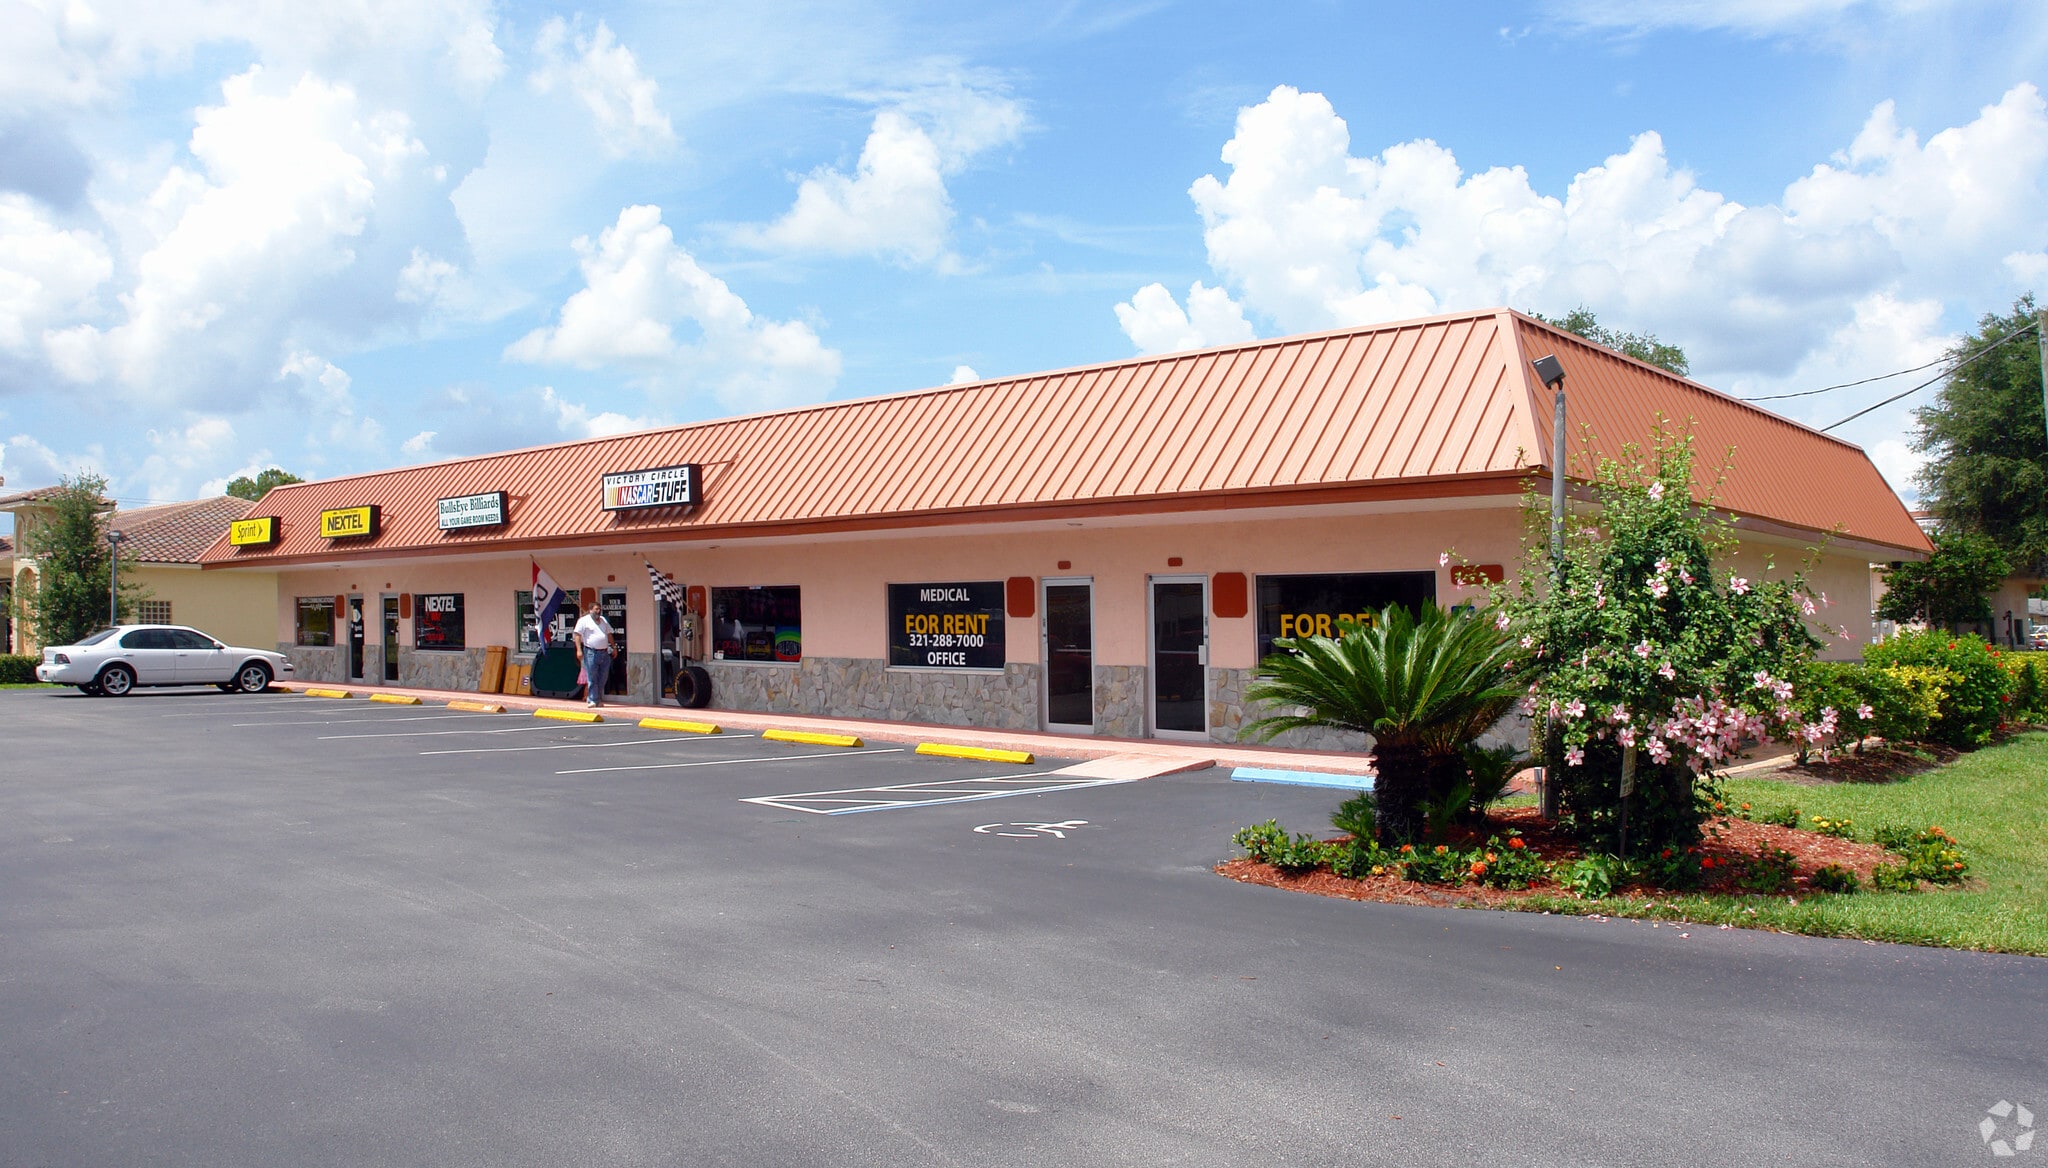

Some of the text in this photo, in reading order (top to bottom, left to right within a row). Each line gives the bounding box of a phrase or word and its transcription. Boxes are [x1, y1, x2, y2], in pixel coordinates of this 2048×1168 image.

[607, 469, 685, 485] VICTORY CIRCLE
[620, 480, 687, 505] NASCAR STUFF
[440, 496, 499, 515] BullsEye Billiards
[327, 513, 363, 532] NEXTEL
[441, 513, 499, 527] ALL YOUR GAME ROOM NEEDS
[237, 522, 256, 542] Sprint
[920, 588, 970, 602] MEDICAL
[425, 596, 456, 612] NEXTEL
[905, 614, 990, 635] FOR RENT
[1280, 613, 1332, 638] FOR
[909, 634, 984, 647] 321-288-7000
[927, 652, 966, 665] OFFICE
